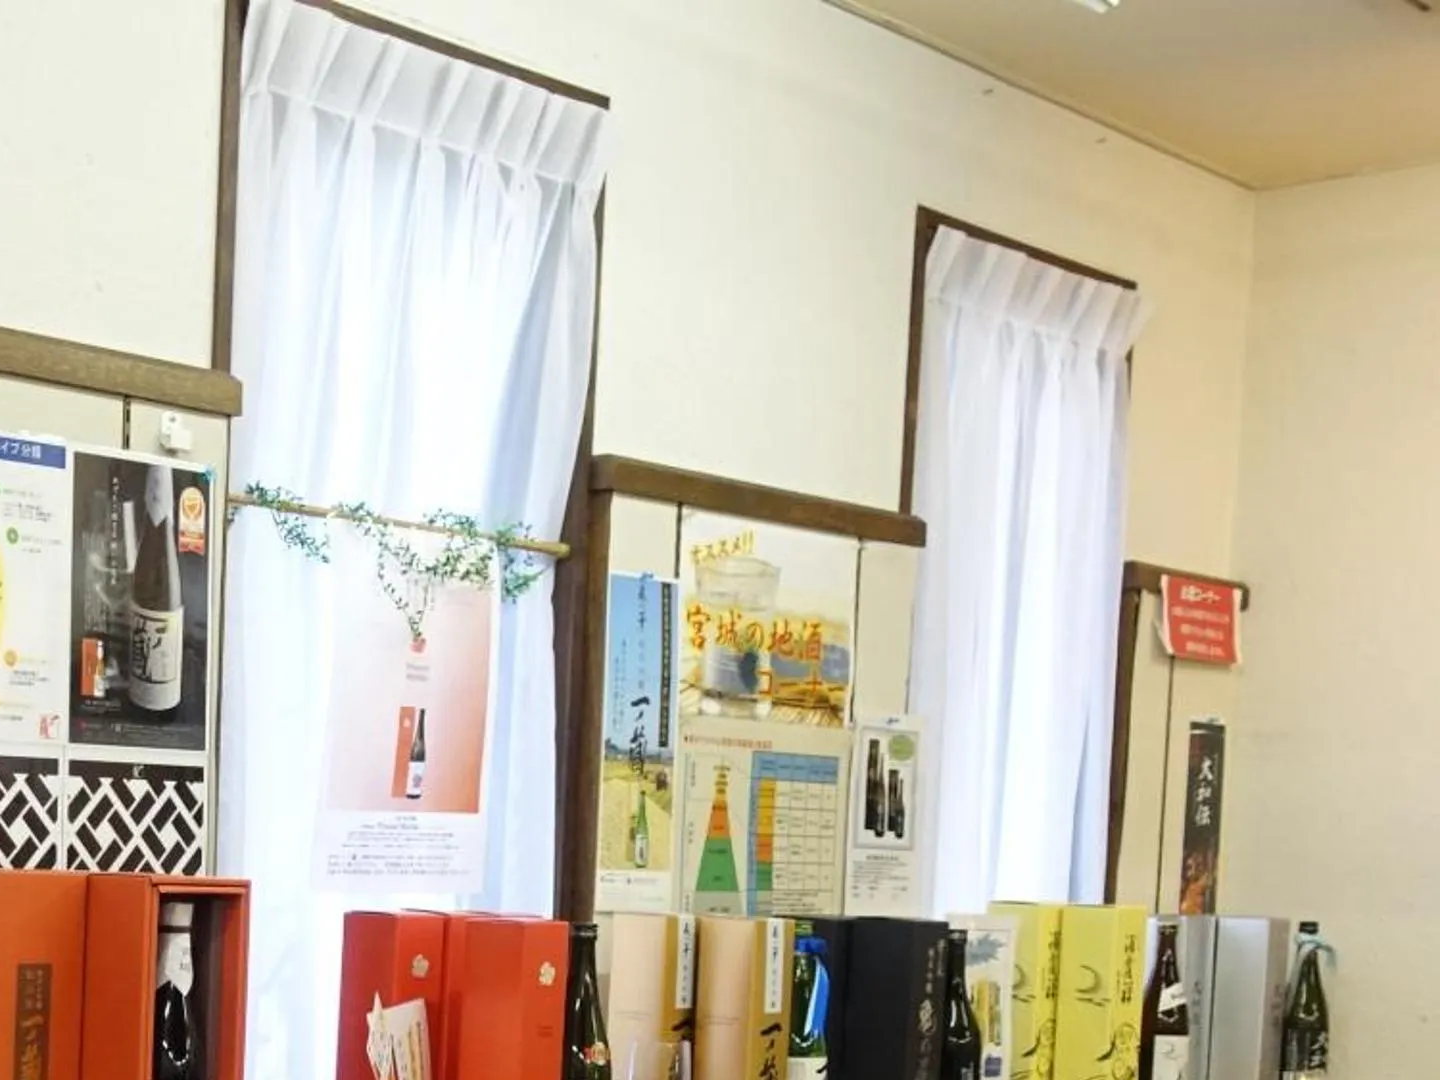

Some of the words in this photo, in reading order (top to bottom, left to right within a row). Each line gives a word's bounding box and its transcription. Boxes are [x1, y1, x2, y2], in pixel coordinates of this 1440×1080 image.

[686, 603, 822, 662] 宮城の地酒
[757, 668, 846, 697] コーナー
